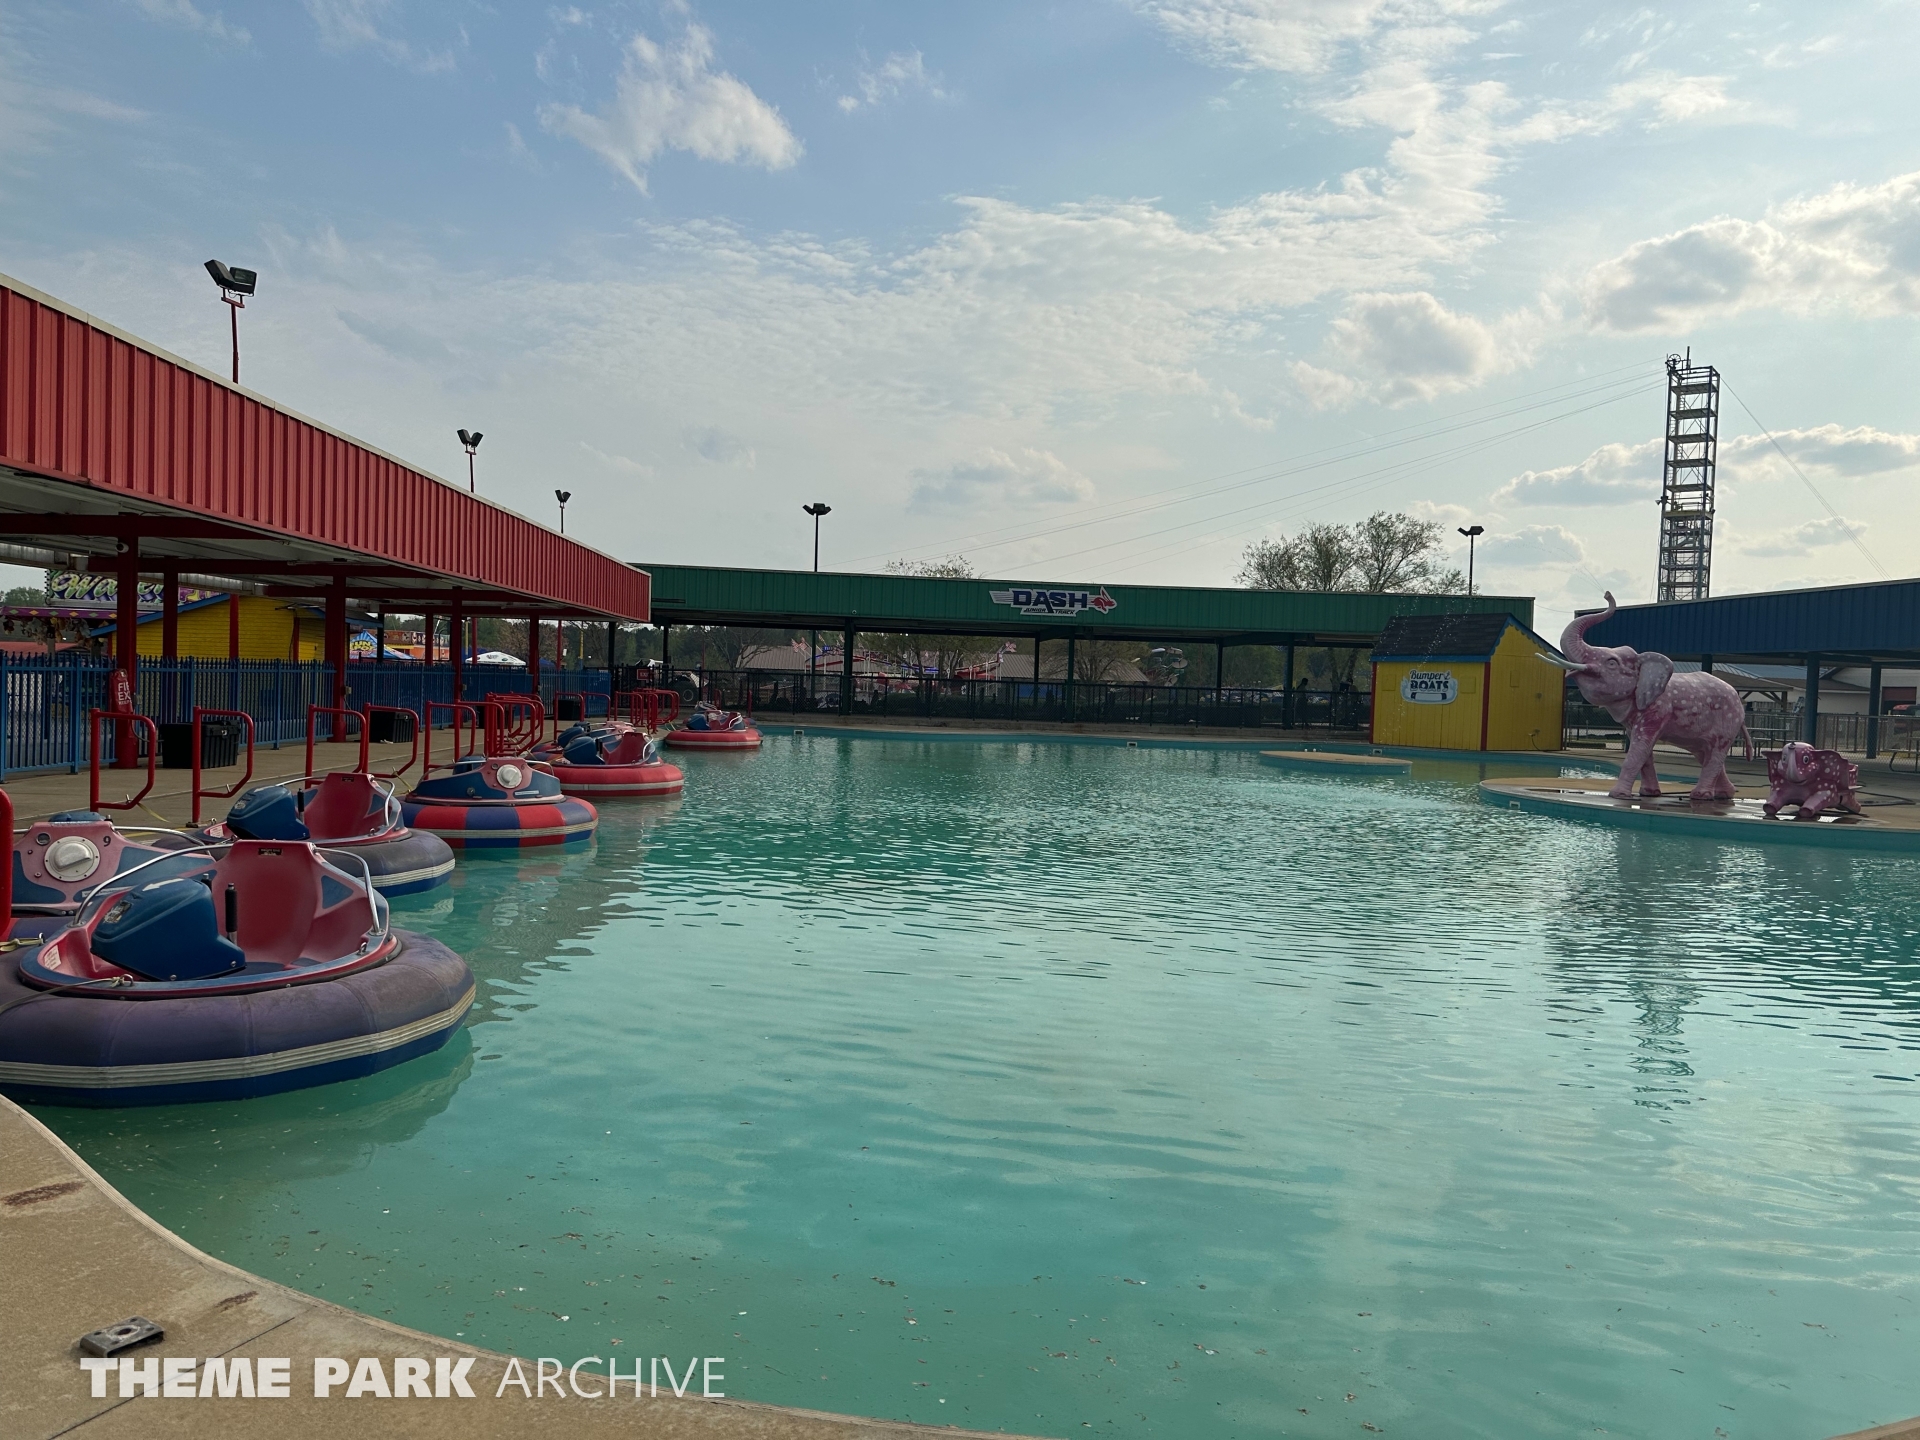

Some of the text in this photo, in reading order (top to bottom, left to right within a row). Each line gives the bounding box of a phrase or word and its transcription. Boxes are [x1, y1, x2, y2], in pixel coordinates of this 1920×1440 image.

[1012, 590, 1088, 613] DASH
[1410, 670, 1445, 682] Bumper
[1410, 680, 1449, 691] BOATS
[103, 835, 111, 847] 9
